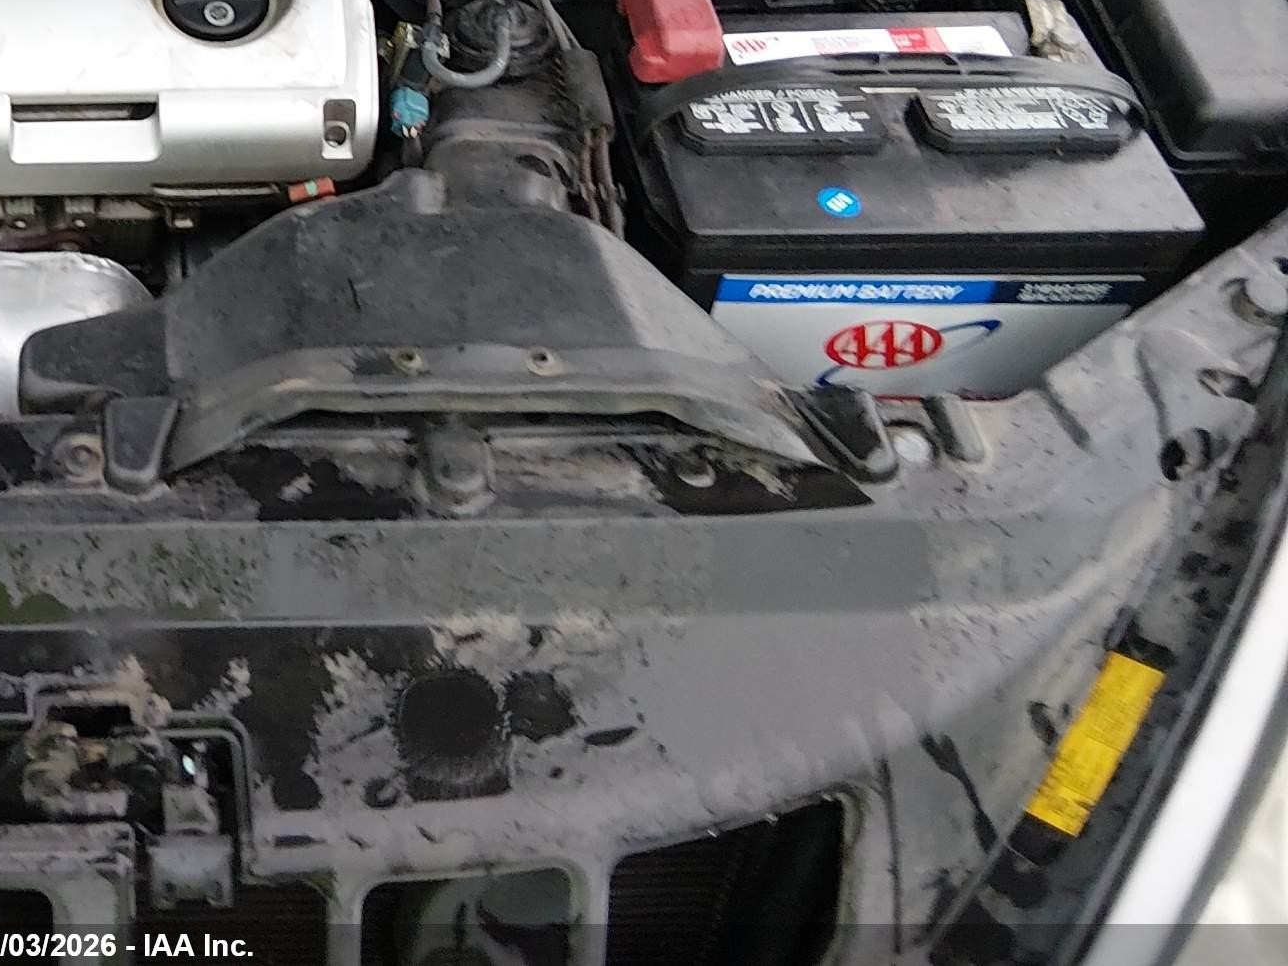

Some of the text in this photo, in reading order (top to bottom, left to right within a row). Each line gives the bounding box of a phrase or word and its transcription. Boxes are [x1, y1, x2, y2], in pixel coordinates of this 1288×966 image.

[749, 283, 964, 299] PREMIUM BATTERY
[834, 323, 930, 364] AAA
